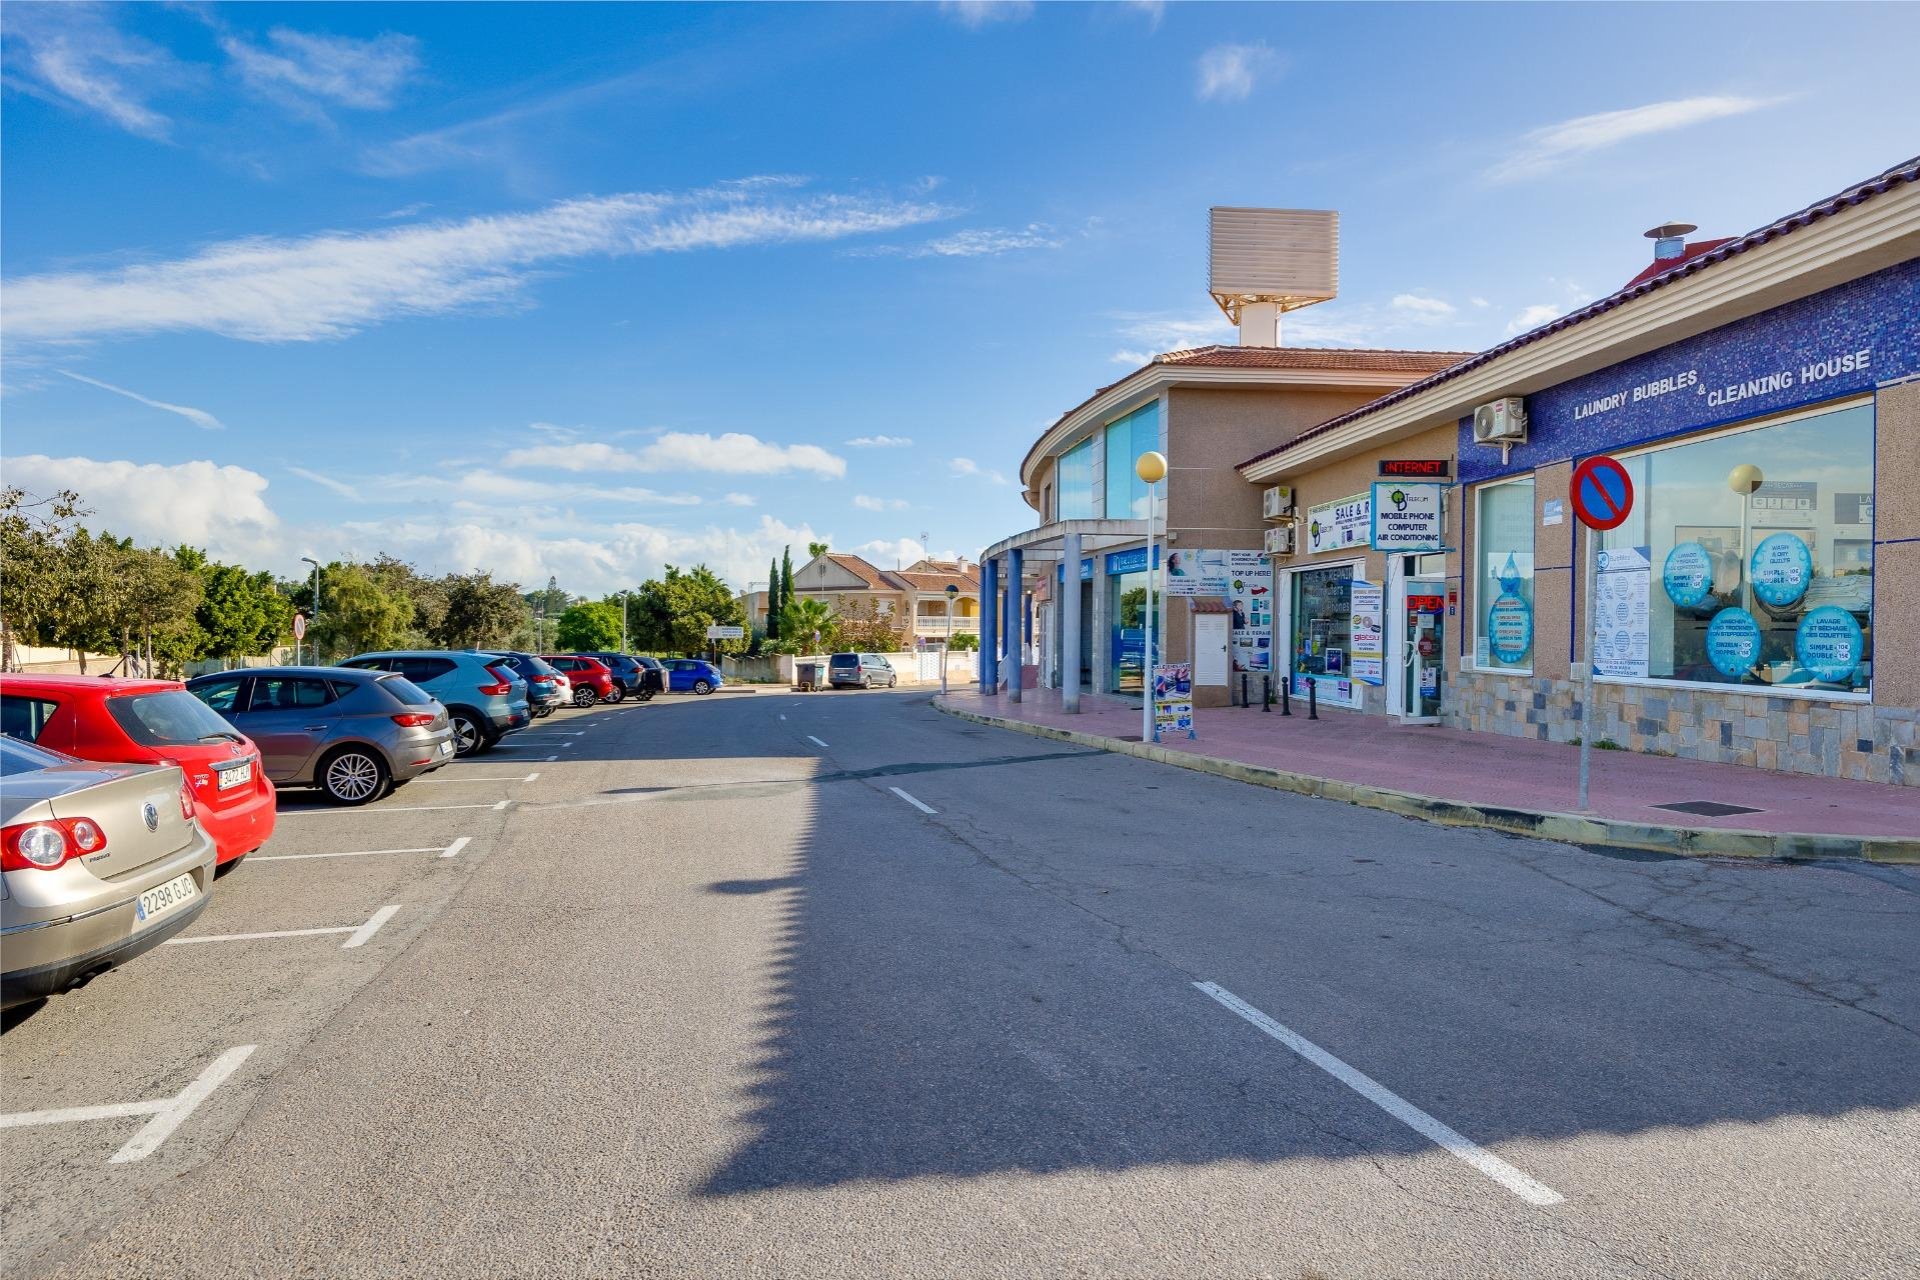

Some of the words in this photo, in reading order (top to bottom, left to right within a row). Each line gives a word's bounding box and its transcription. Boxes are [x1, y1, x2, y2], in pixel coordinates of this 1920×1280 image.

[1574, 391, 1627, 420] LAUNDRY
[1633, 370, 1697, 401] BUBBLES
[1697, 384, 1707, 395] &
[1708, 372, 1793, 407] CLEANING
[1801, 350, 1870, 384] HOUSE
[1385, 462, 1441, 472] INTERNET
[1335, 505, 1353, 520] SALE
[1356, 504, 1361, 515] &
[1407, 595, 1444, 610] OPEN
[224, 768, 239, 785] 3472
[143, 886, 173, 915] 2298
[173, 877, 192, 899] GJC
